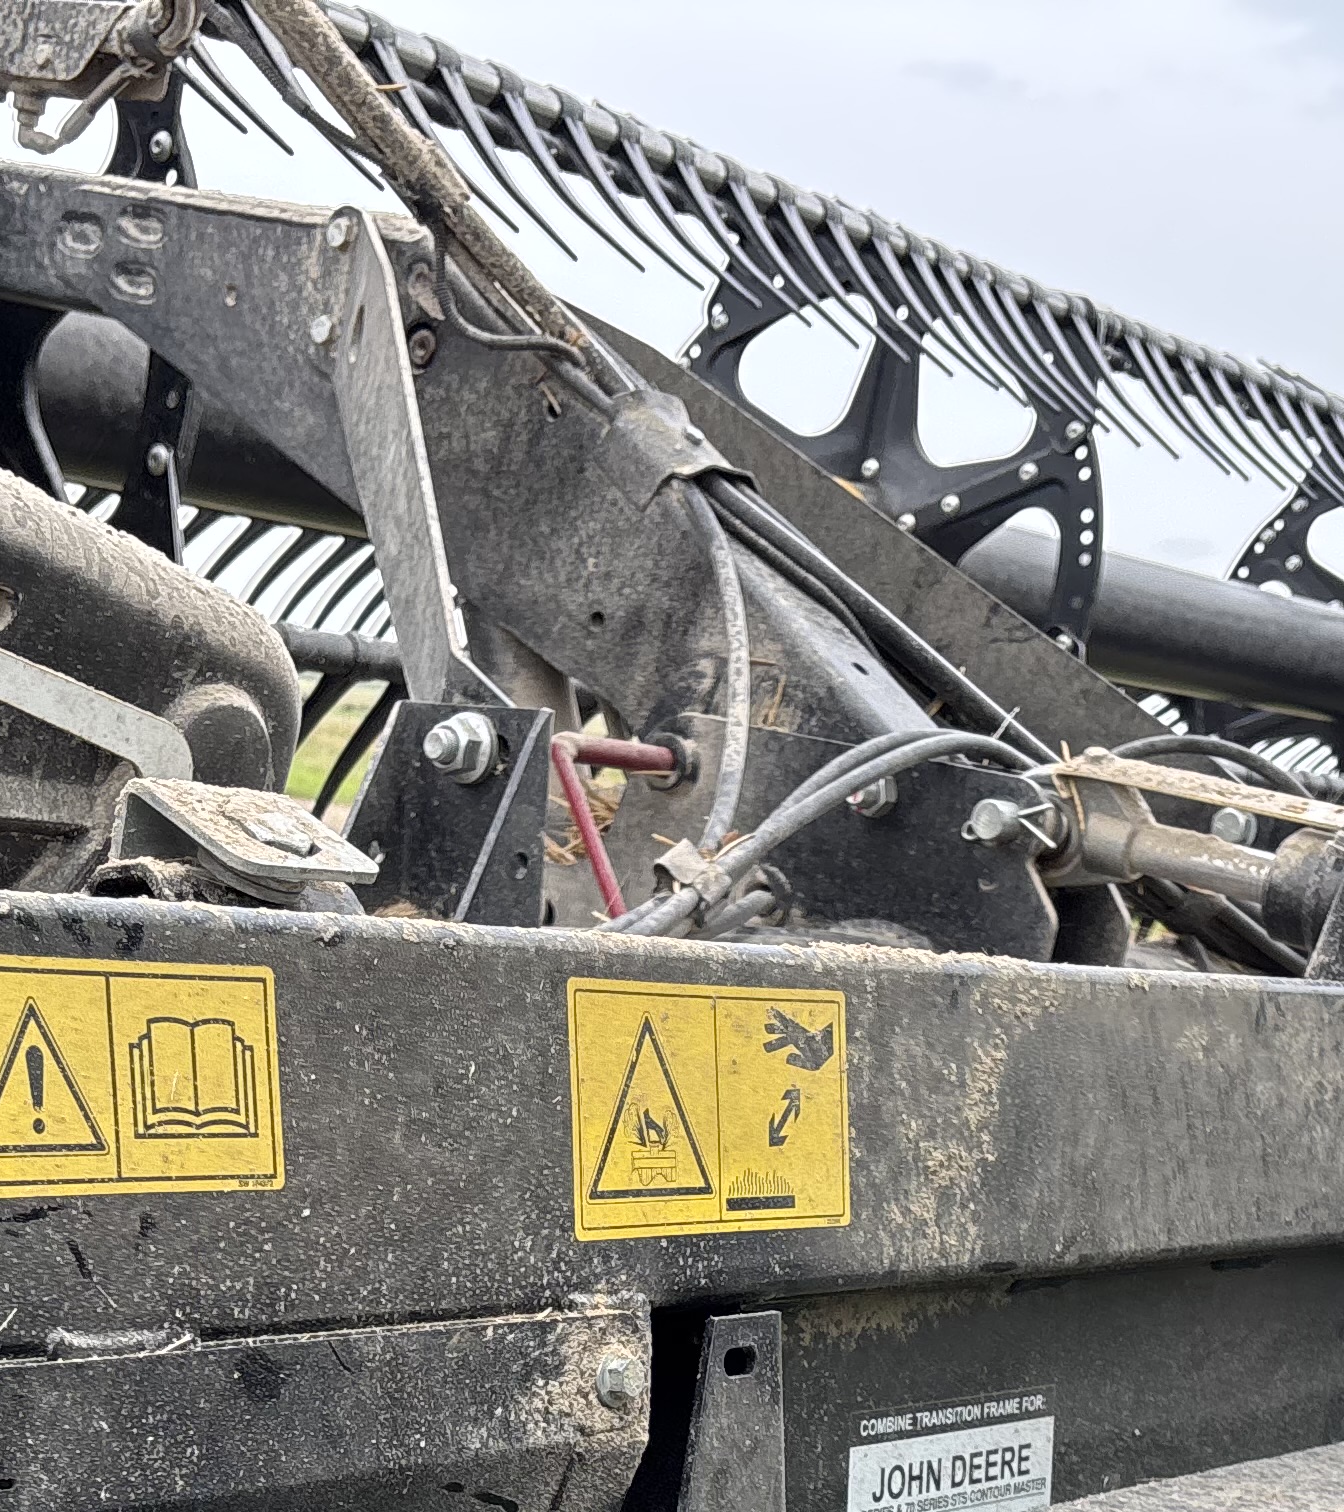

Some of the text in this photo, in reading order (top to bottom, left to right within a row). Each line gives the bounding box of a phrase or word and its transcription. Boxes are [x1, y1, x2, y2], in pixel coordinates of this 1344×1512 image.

[860, 1394, 1046, 1436] COMBINE TRANSITION FRAME FOR:
[872, 1443, 1031, 1503] JOHN DEERE
[969, 1483, 1011, 1503] CONTOUR
[1013, 1477, 1047, 1495] MASTER
